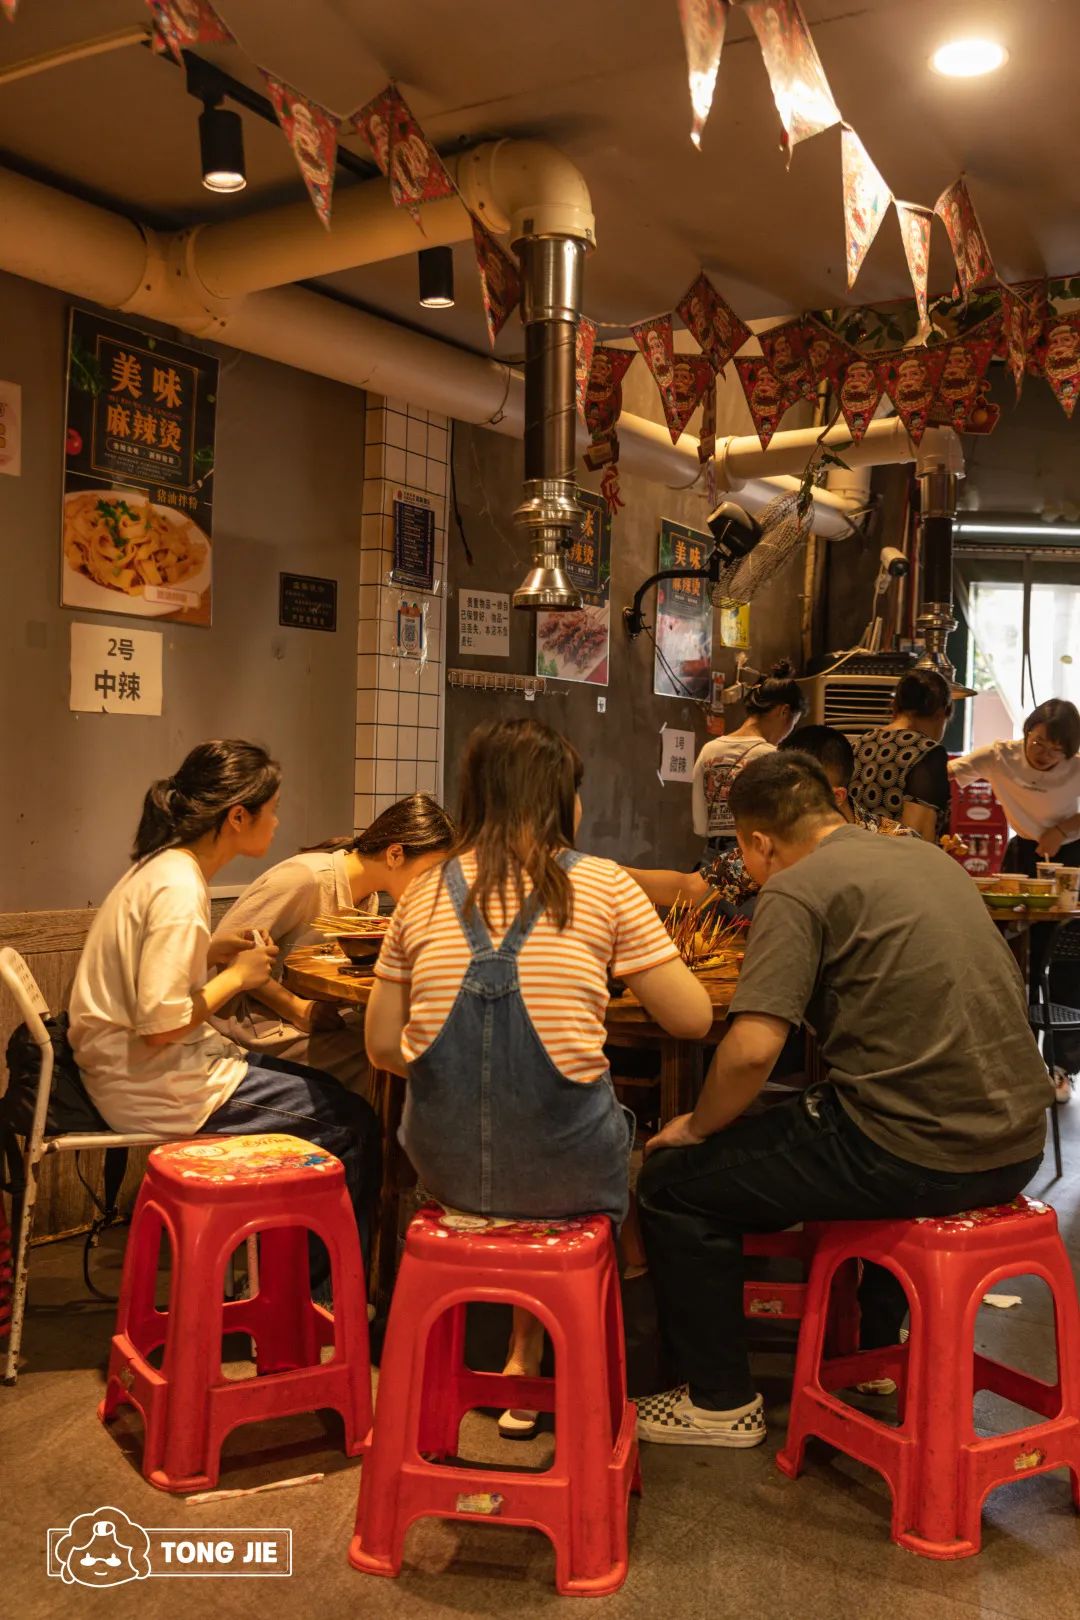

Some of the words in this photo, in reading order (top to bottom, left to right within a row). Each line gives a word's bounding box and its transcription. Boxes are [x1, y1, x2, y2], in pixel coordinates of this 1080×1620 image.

[110, 351, 184, 409] 美味
[106, 404, 182, 452] 麻辣烫
[674, 540, 701, 570] 美味
[107, 637, 135, 661] 2号
[94, 669, 141, 702] 中辣
